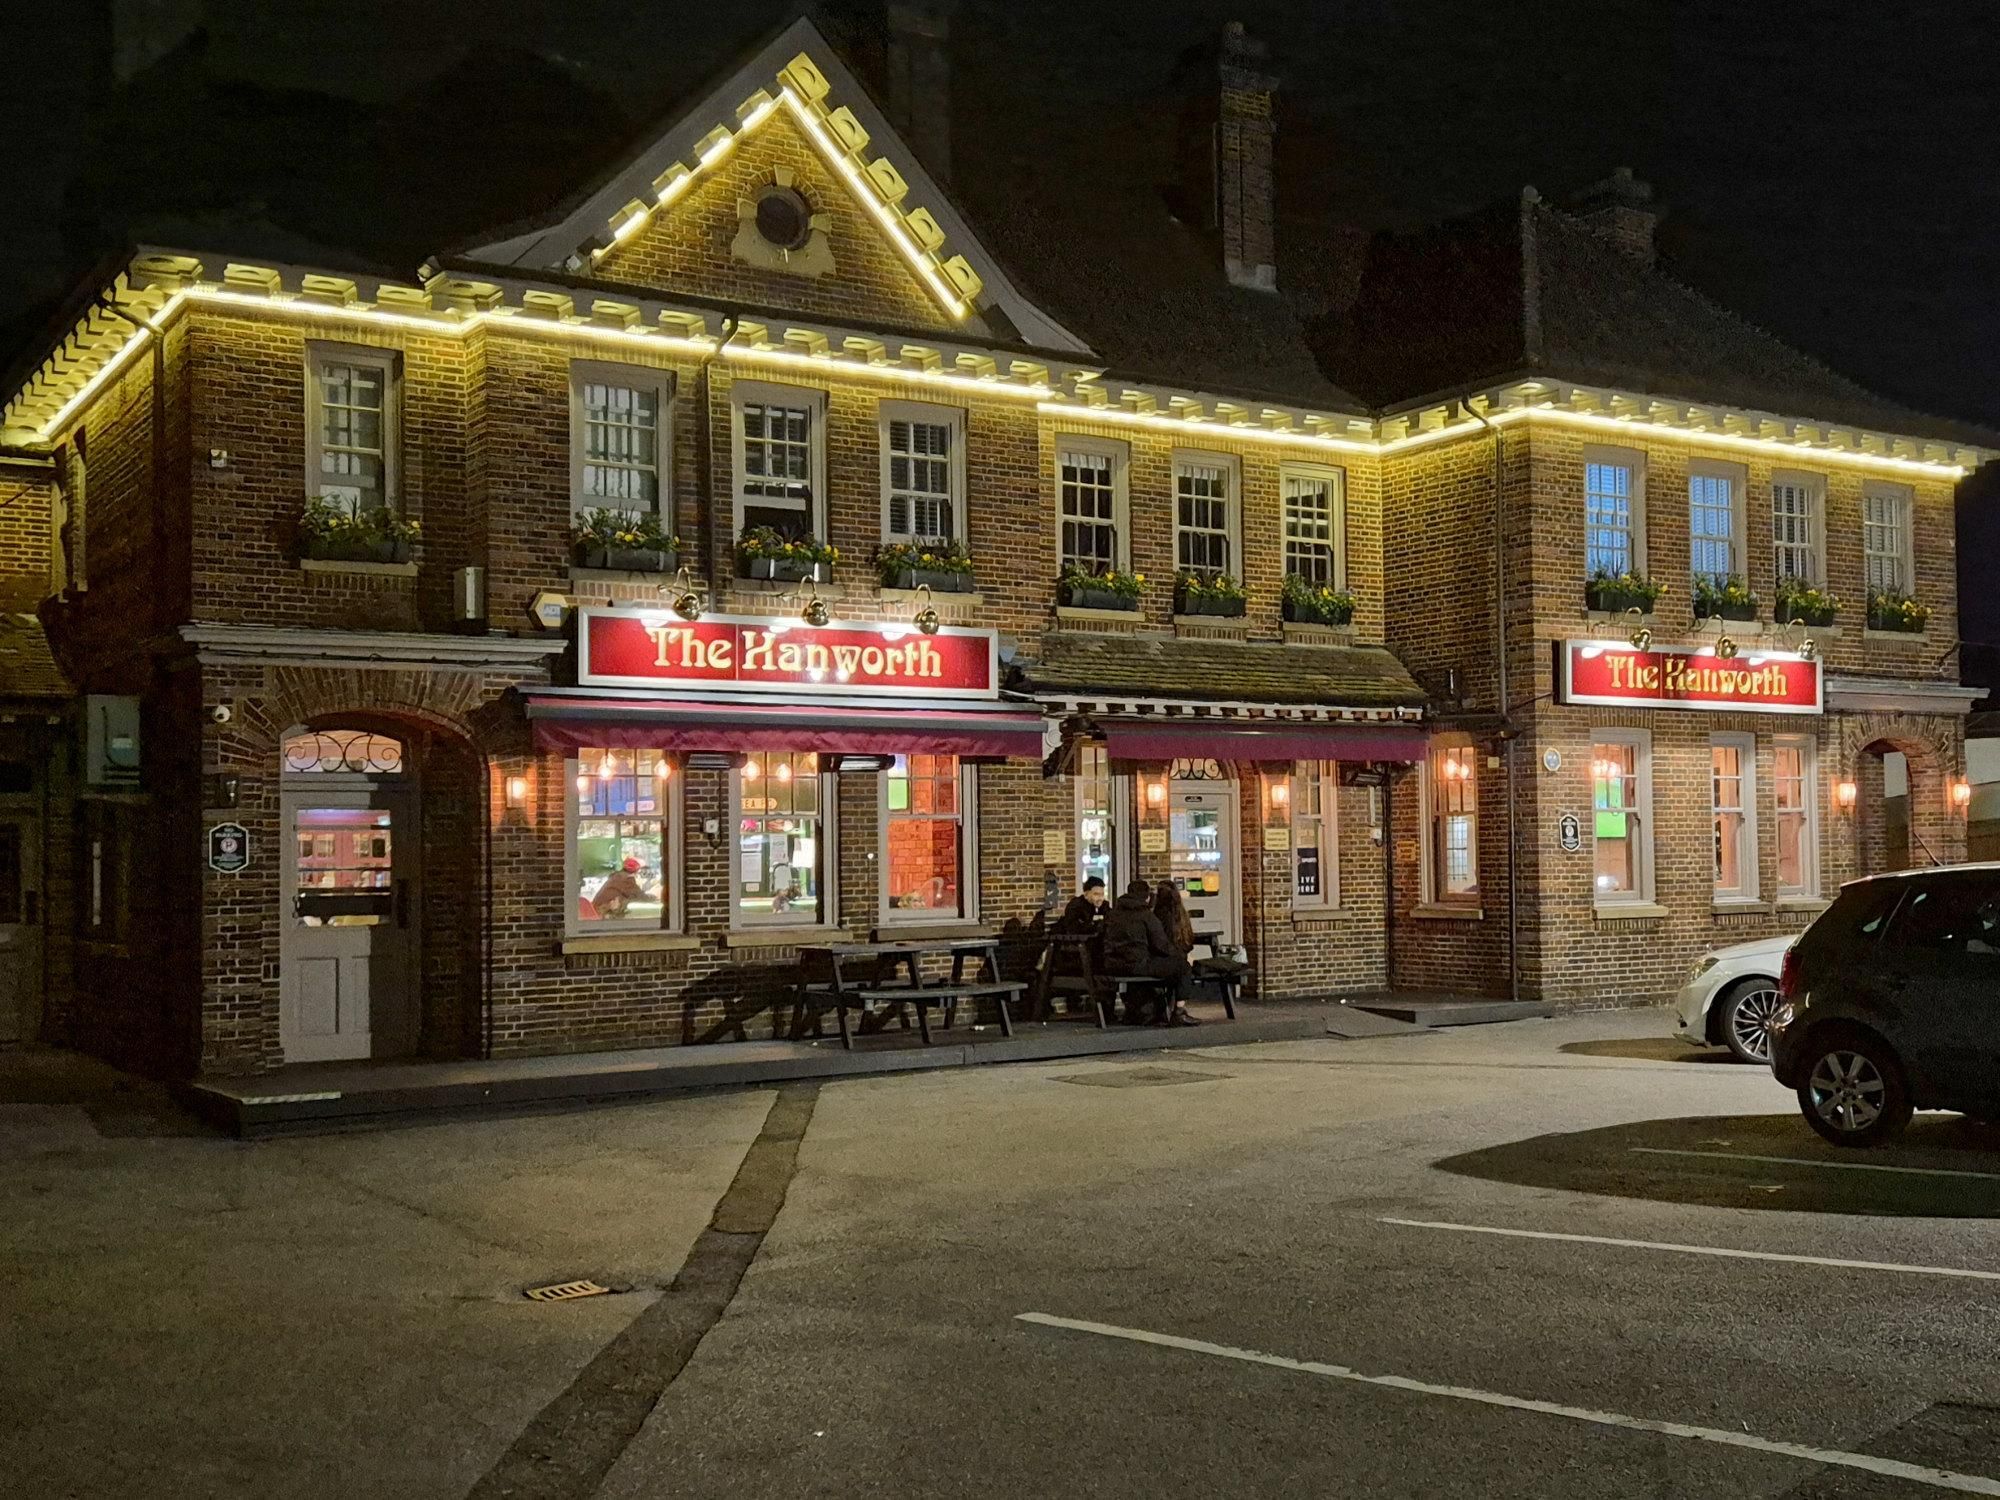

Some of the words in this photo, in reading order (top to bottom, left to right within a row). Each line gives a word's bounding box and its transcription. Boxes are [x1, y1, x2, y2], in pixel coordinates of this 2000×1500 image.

[644, 627, 732, 669] The
[742, 630, 943, 678] Hanworth
[1605, 654, 1659, 689] The
[1664, 658, 1787, 696] Hanworth
